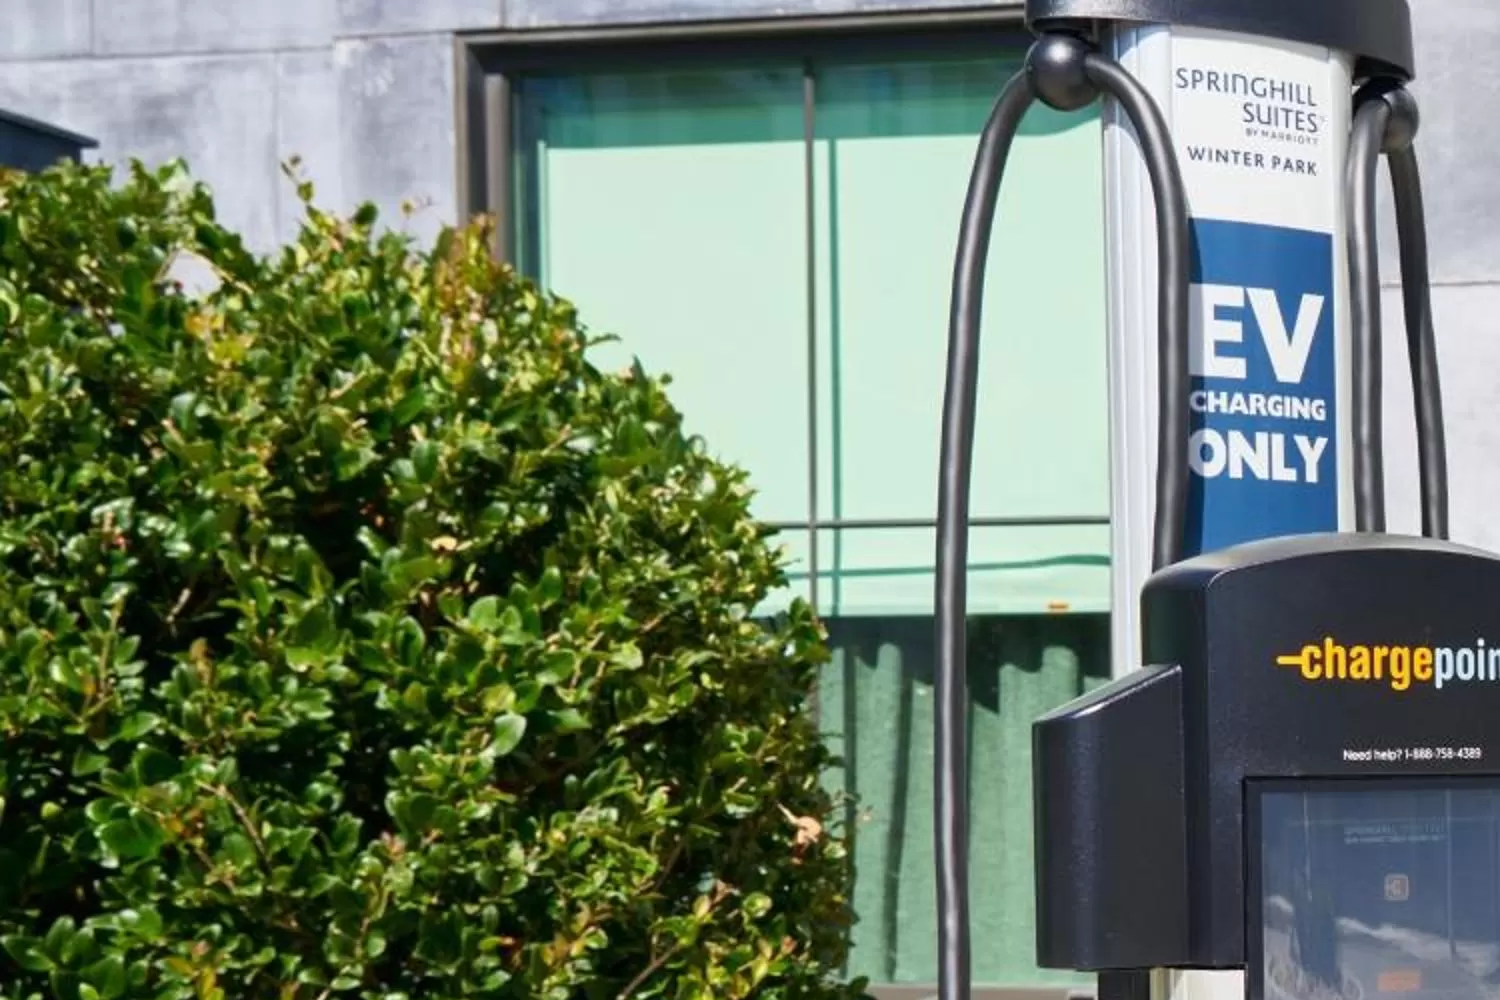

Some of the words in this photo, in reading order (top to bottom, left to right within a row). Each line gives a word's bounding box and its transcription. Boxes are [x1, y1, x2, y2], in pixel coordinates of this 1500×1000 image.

[1175, 67, 1318, 107] SPRINGHILL
[1242, 102, 1319, 133] SUITES
[1187, 145, 1265, 168] WINTER
[1271, 155, 1317, 176] PARK
[1188, 283, 1325, 384] EV
[1189, 390, 1327, 421] CHARGING
[1188, 427, 1329, 484] ONLY
[1343, 749, 1372, 760] Need
[1374, 748, 1402, 761] help?
